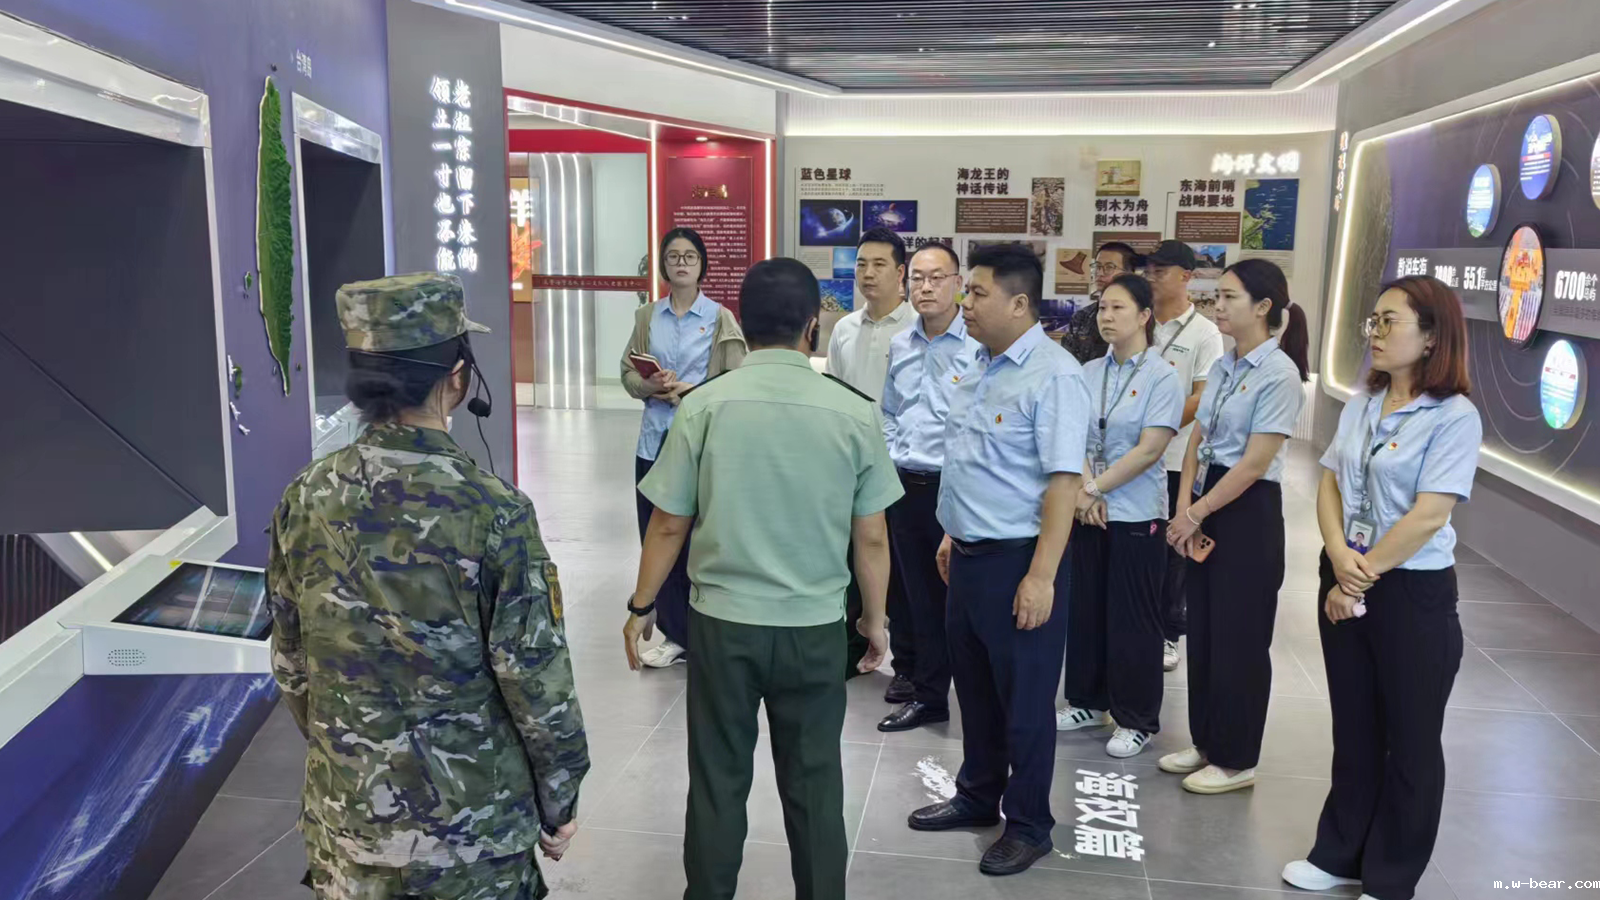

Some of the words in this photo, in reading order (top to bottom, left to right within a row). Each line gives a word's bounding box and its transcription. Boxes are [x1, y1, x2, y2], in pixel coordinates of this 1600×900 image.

[429, 75, 456, 271] 领土一寸也不能
[452, 79, 478, 272] 老祖宗留下来的
[801, 168, 852, 181] 蓝色星球
[957, 168, 1009, 180] 海龙王的
[956, 183, 1009, 195] 神话传说
[1180, 179, 1235, 192] 东海前哨
[1179, 194, 1234, 207] 战略要地
[1554, 270, 1586, 301] 6700
[1074, 769, 1145, 861] 海权篇
